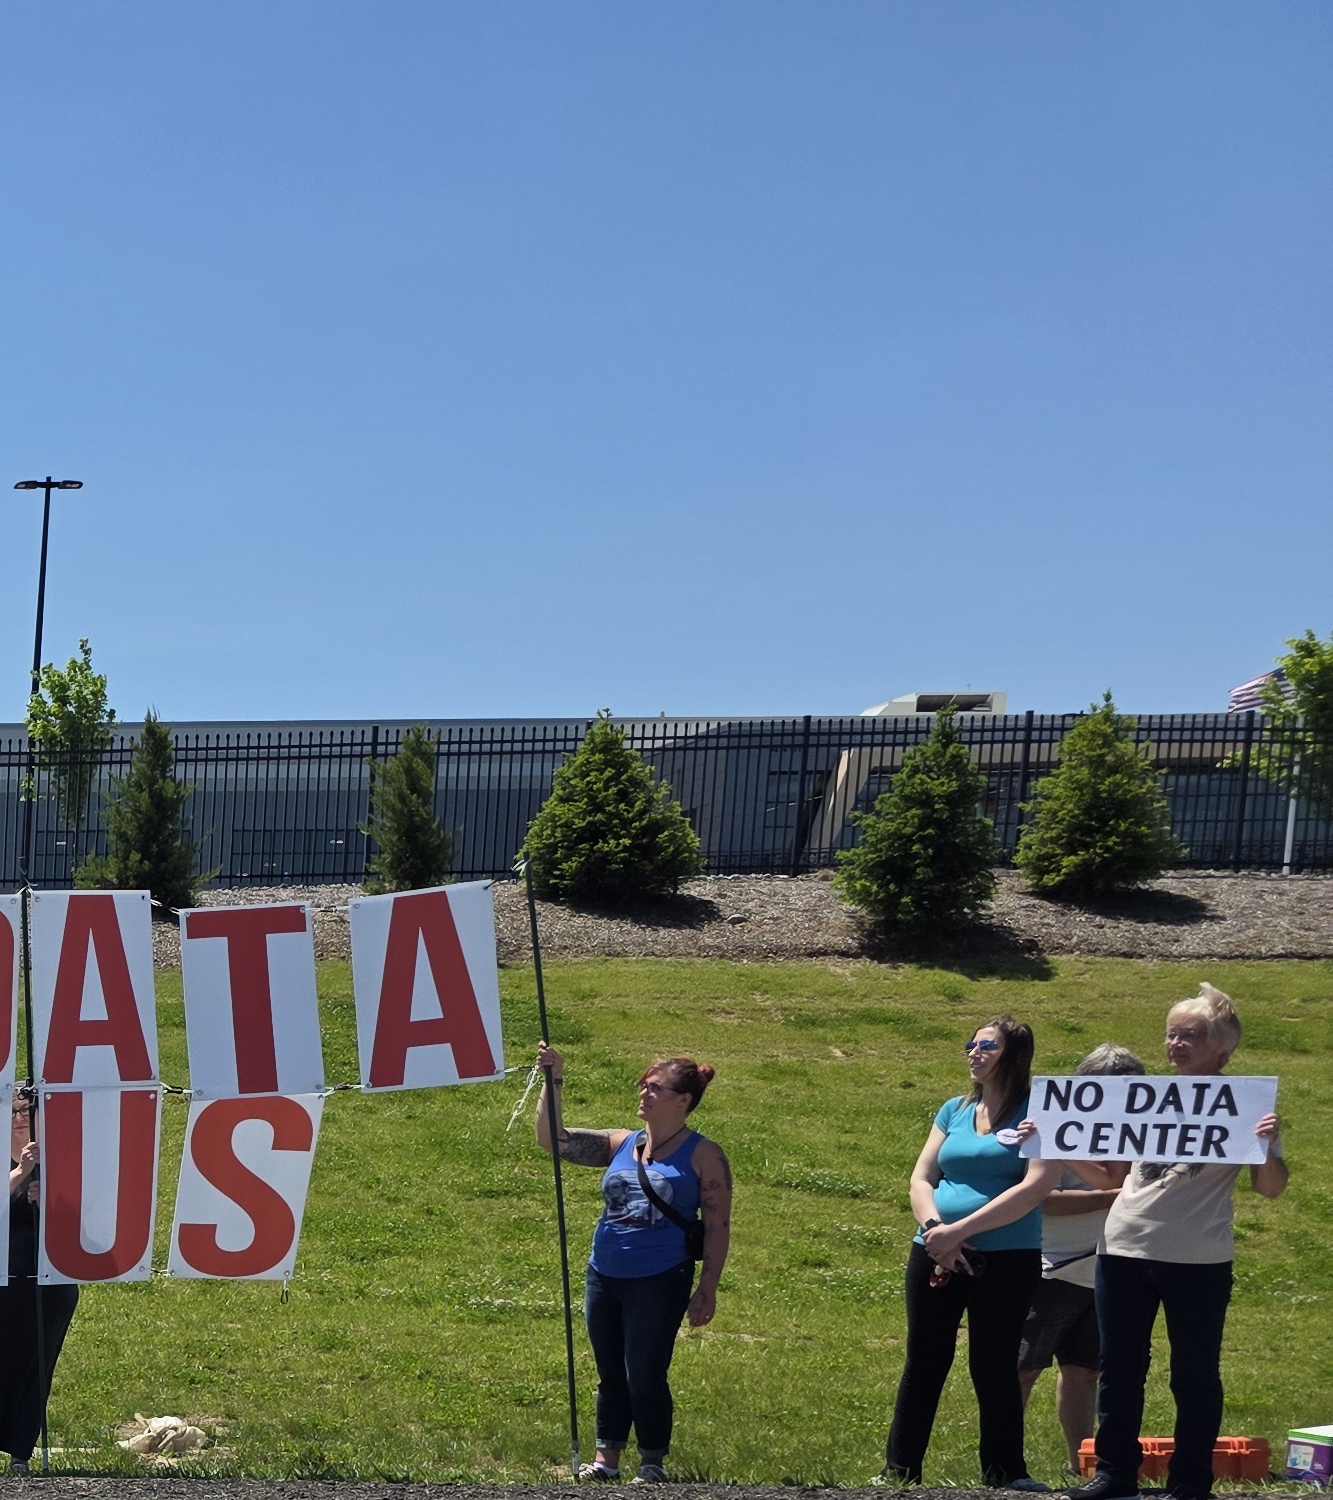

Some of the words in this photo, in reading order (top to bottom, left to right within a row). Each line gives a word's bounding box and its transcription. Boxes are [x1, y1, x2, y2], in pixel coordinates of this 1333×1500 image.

[1042, 1079, 1104, 1112] NO
[1124, 1082, 1239, 1117] DATA
[1054, 1120, 1230, 1158] CENTER
[43, 1090, 314, 1281] US
